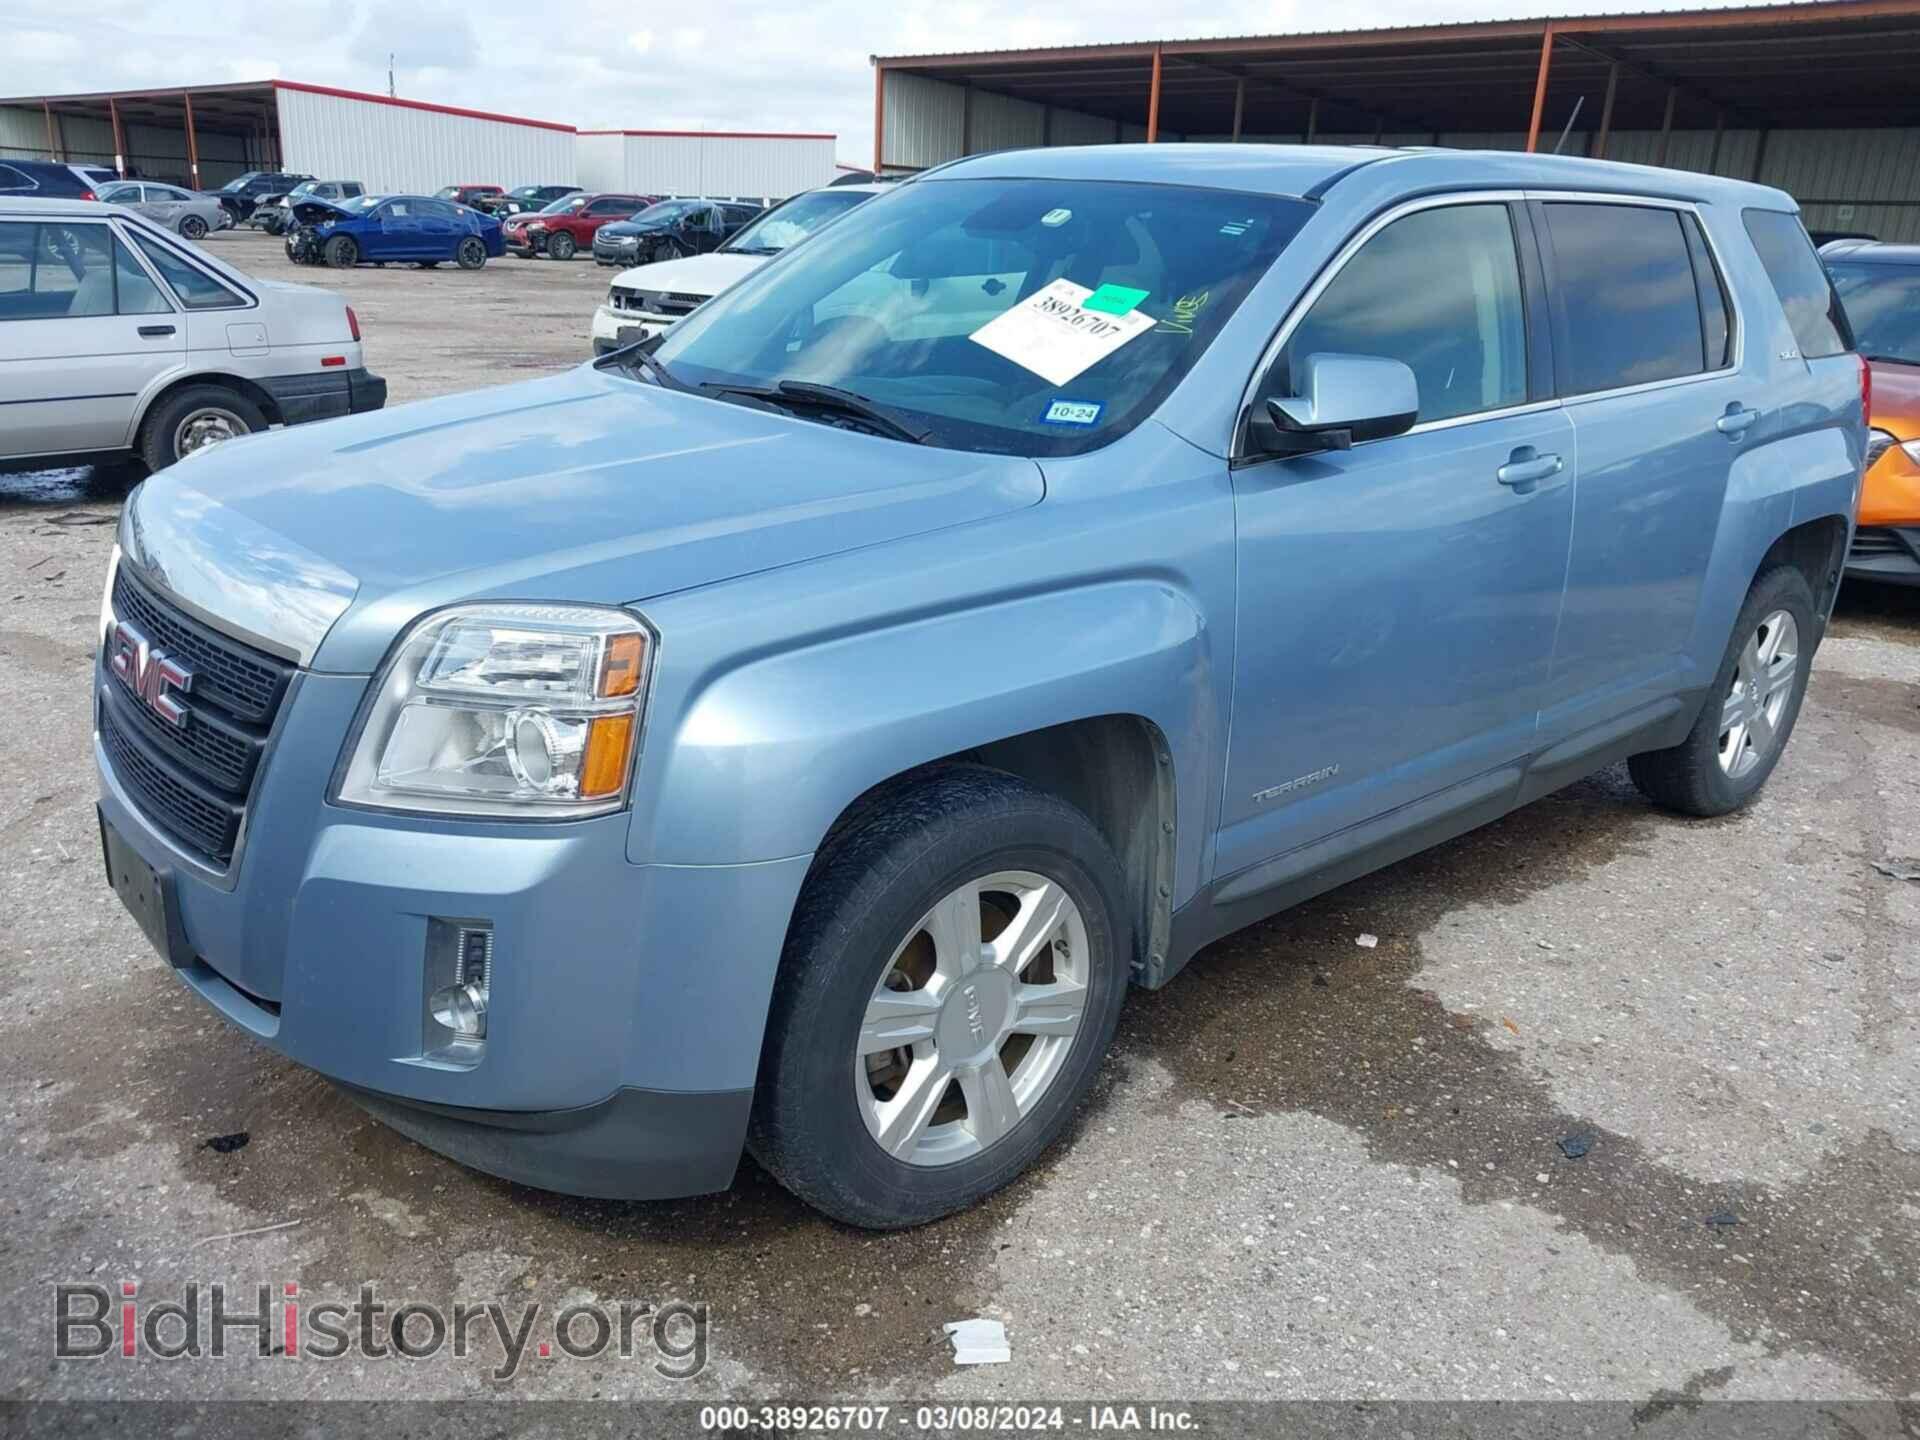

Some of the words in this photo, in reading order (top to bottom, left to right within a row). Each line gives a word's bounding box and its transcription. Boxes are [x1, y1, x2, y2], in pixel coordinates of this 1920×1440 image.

[1031, 296, 1121, 339] 38926707
[110, 620, 193, 729] GMC
[1252, 762, 1341, 803] TERRAIN
